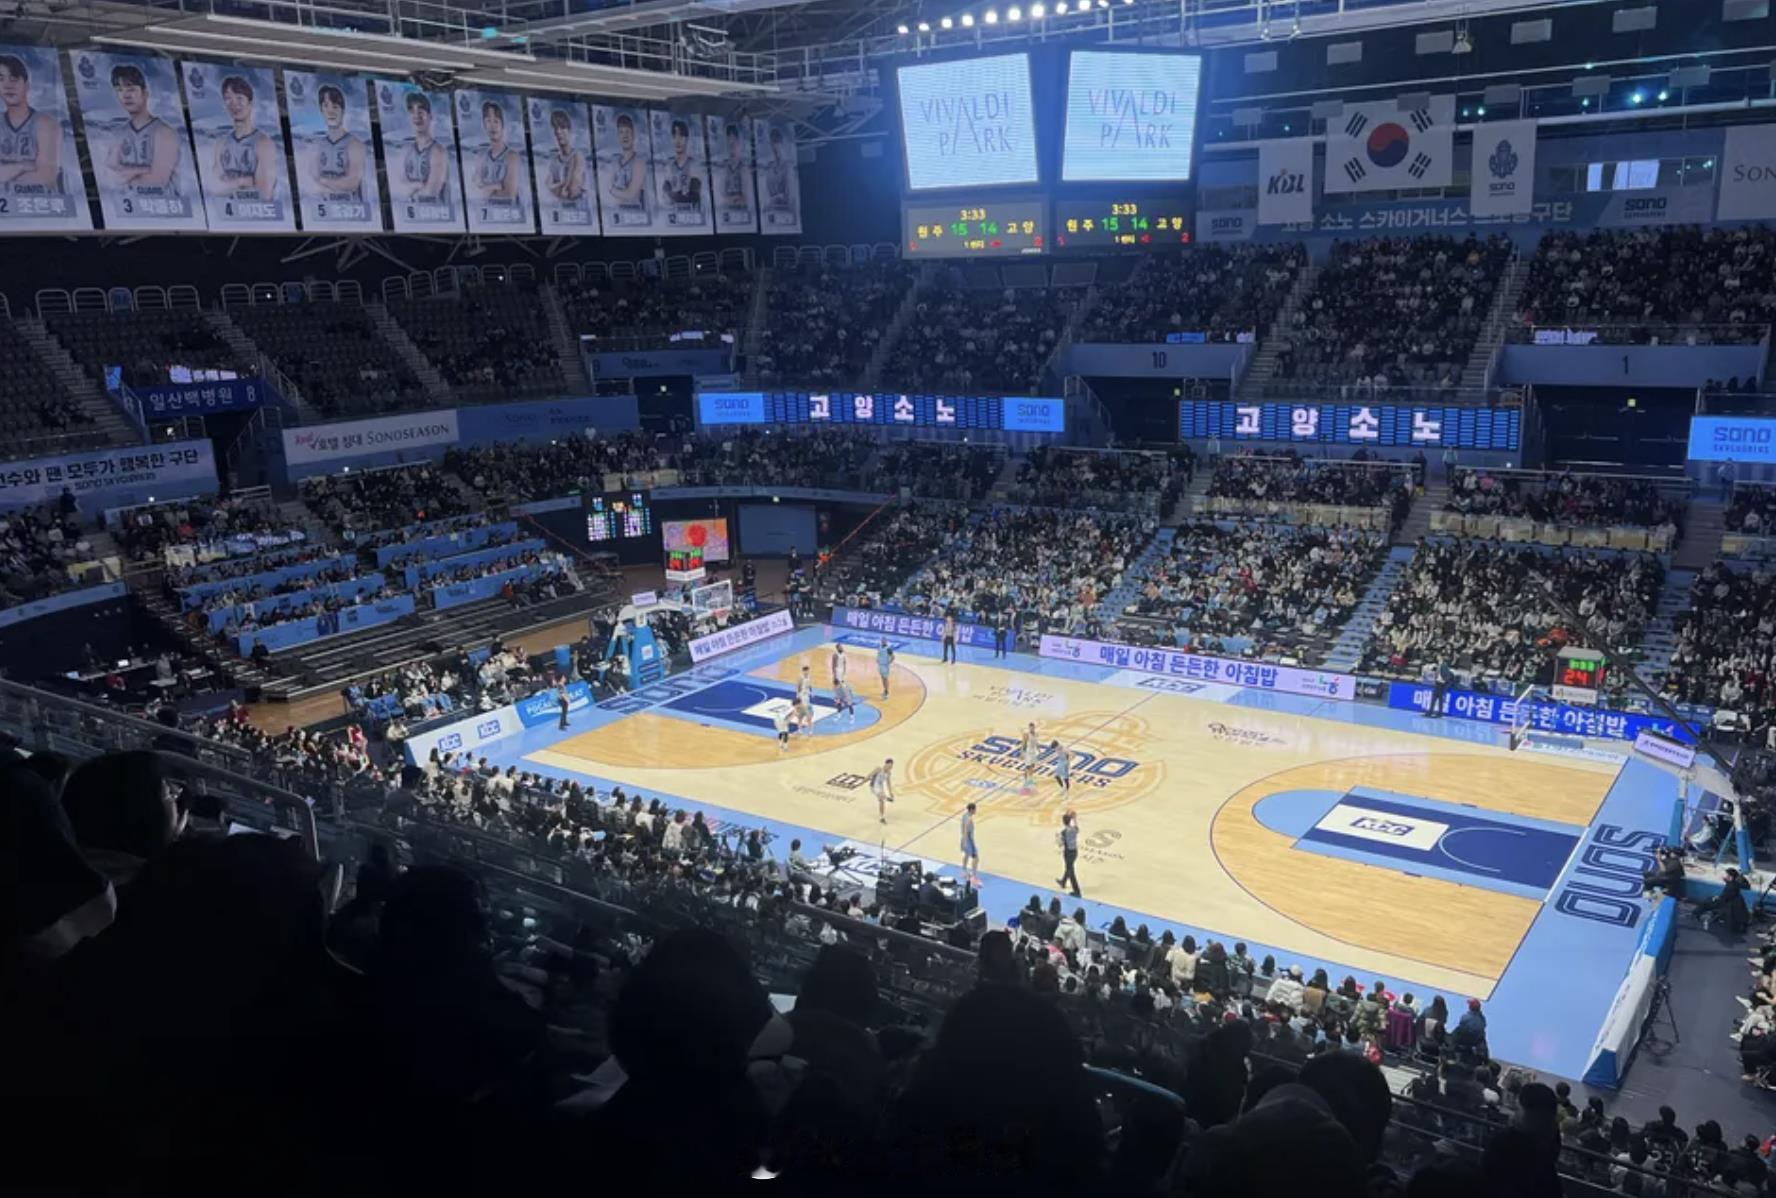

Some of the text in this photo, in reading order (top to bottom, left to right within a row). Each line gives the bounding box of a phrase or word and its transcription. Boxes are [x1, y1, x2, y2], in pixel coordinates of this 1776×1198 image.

[920, 92, 1010, 123] VIVALDI
[1088, 89, 1176, 114] VIVALDI
[939, 123, 1012, 156] PARK
[1101, 121, 1173, 148] PARK
[1267, 169, 1305, 194] KBL
[123, 198, 133, 213] 3
[317, 204, 326, 217] 5
[960, 207, 986, 220] 3:33
[1112, 203, 1137, 215] 3:33
[1101, 217, 1119, 231] 15
[1131, 217, 1150, 231] 14
[1319, 211, 1354, 231] 소노
[1358, 205, 1468, 230] 스카이거너스
[950, 223, 968, 236] 15
[980, 223, 998, 236] 14
[1181, 232, 1190, 244] 2
[1152, 351, 1167, 369] 10
[1621, 355, 1629, 375] 1
[67, 458, 115, 480] 모두가
[168, 447, 200, 466] 구단
[846, 612, 975, 643] 매일 아침 든든한 아밥
[1099, 645, 1131, 667] 매일
[1133, 651, 1165, 671] 아침
[1169, 655, 1221, 680] 든든한
[1225, 662, 1279, 688] 아침밥
[1564, 668, 1588, 685] 24
[1455, 695, 1494, 719] 아침
